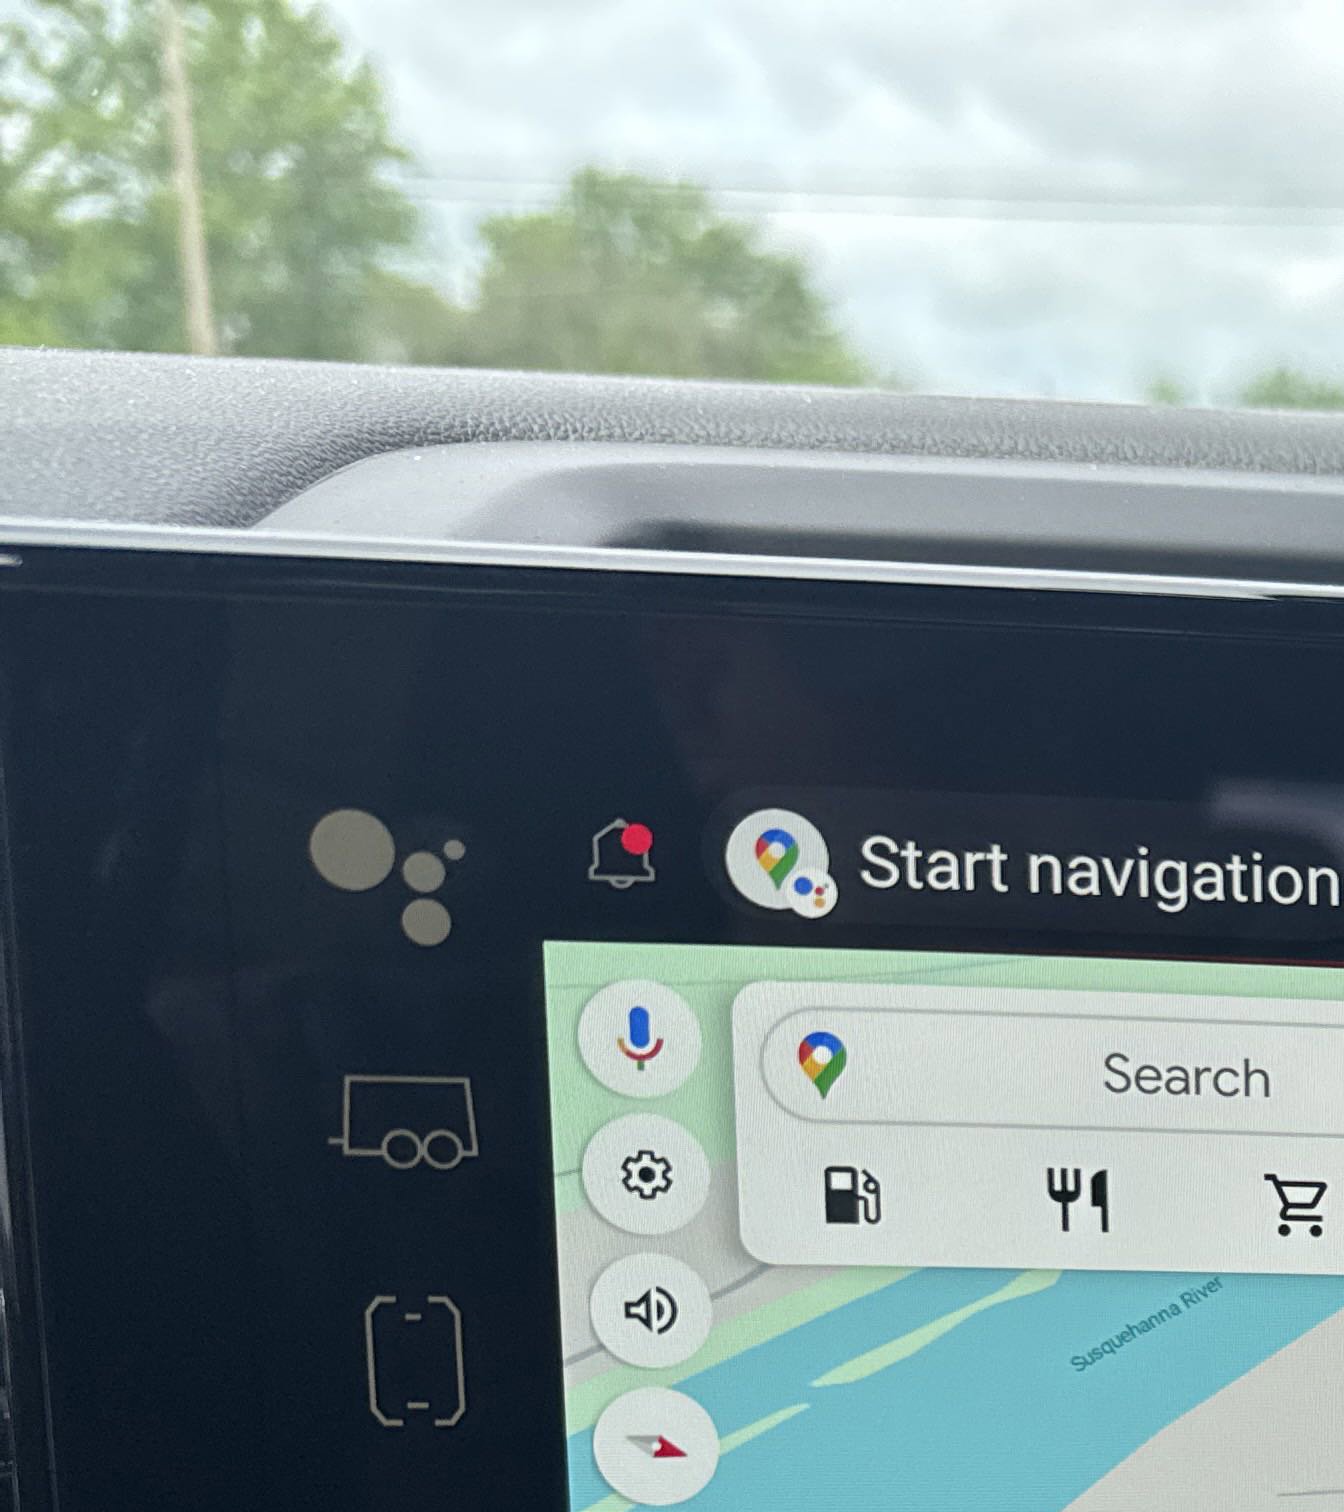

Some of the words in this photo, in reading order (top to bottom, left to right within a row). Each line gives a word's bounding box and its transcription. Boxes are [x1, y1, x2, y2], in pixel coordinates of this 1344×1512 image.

[860, 835, 1009, 894] Start
[1028, 844, 1343, 913] navigation
[1103, 1052, 1272, 1098] Search
[1069, 1302, 1183, 1373] Susquehanna
[1179, 1275, 1224, 1310] River
